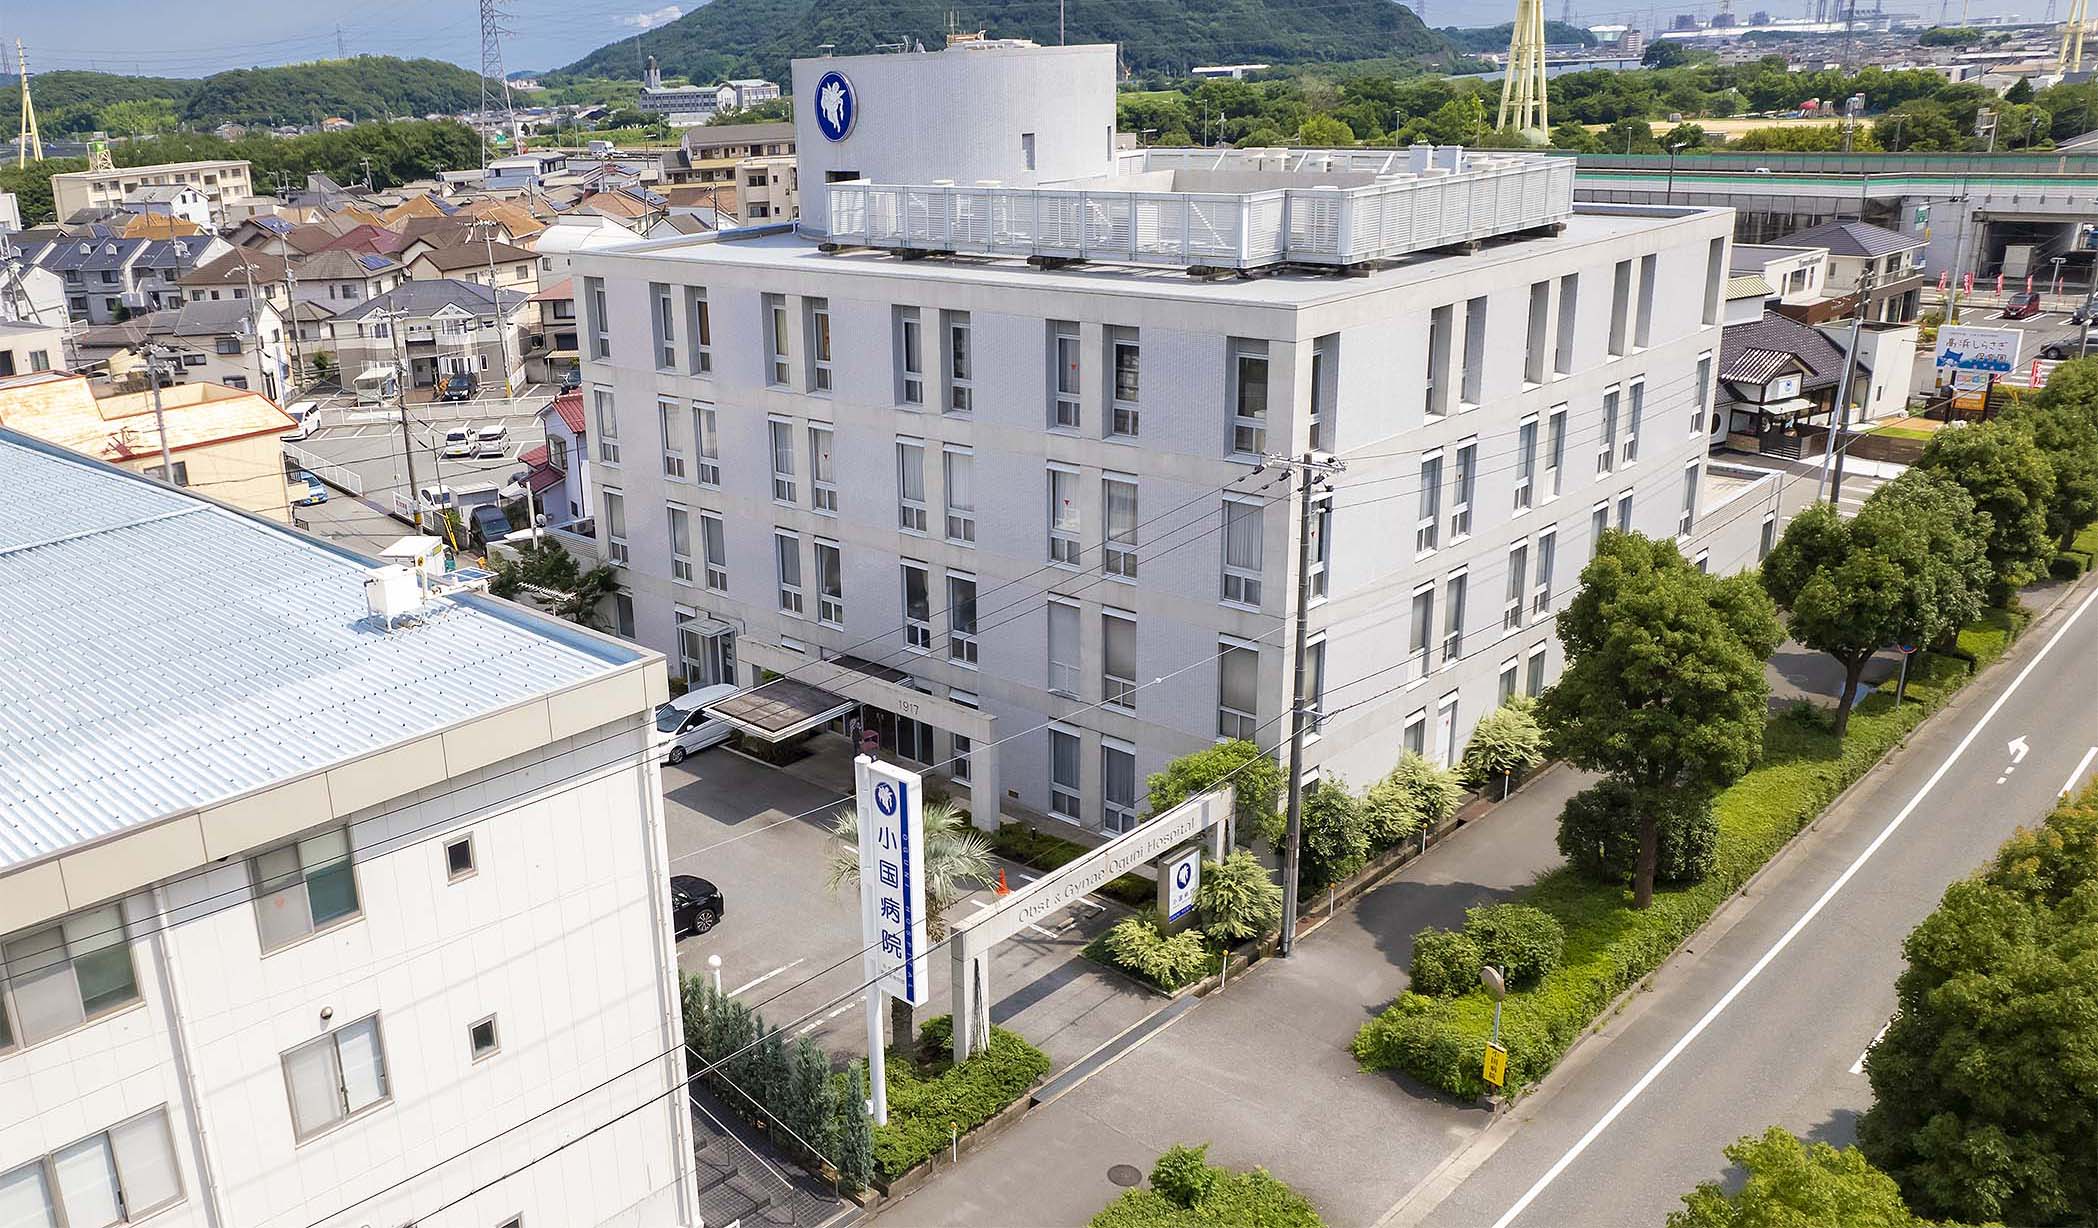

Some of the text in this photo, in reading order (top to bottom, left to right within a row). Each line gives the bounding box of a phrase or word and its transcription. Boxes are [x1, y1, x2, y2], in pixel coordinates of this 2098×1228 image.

[899, 700, 919, 715] 1917
[878, 826, 902, 959] 小国病院
[902, 833, 914, 988] OGUNI HOSPITAL
[1018, 898, 1050, 923] Obst
[1064, 869, 1105, 898] Gynae
[1109, 846, 1144, 873] Oguni
[1147, 816, 1195, 854] Hospital
